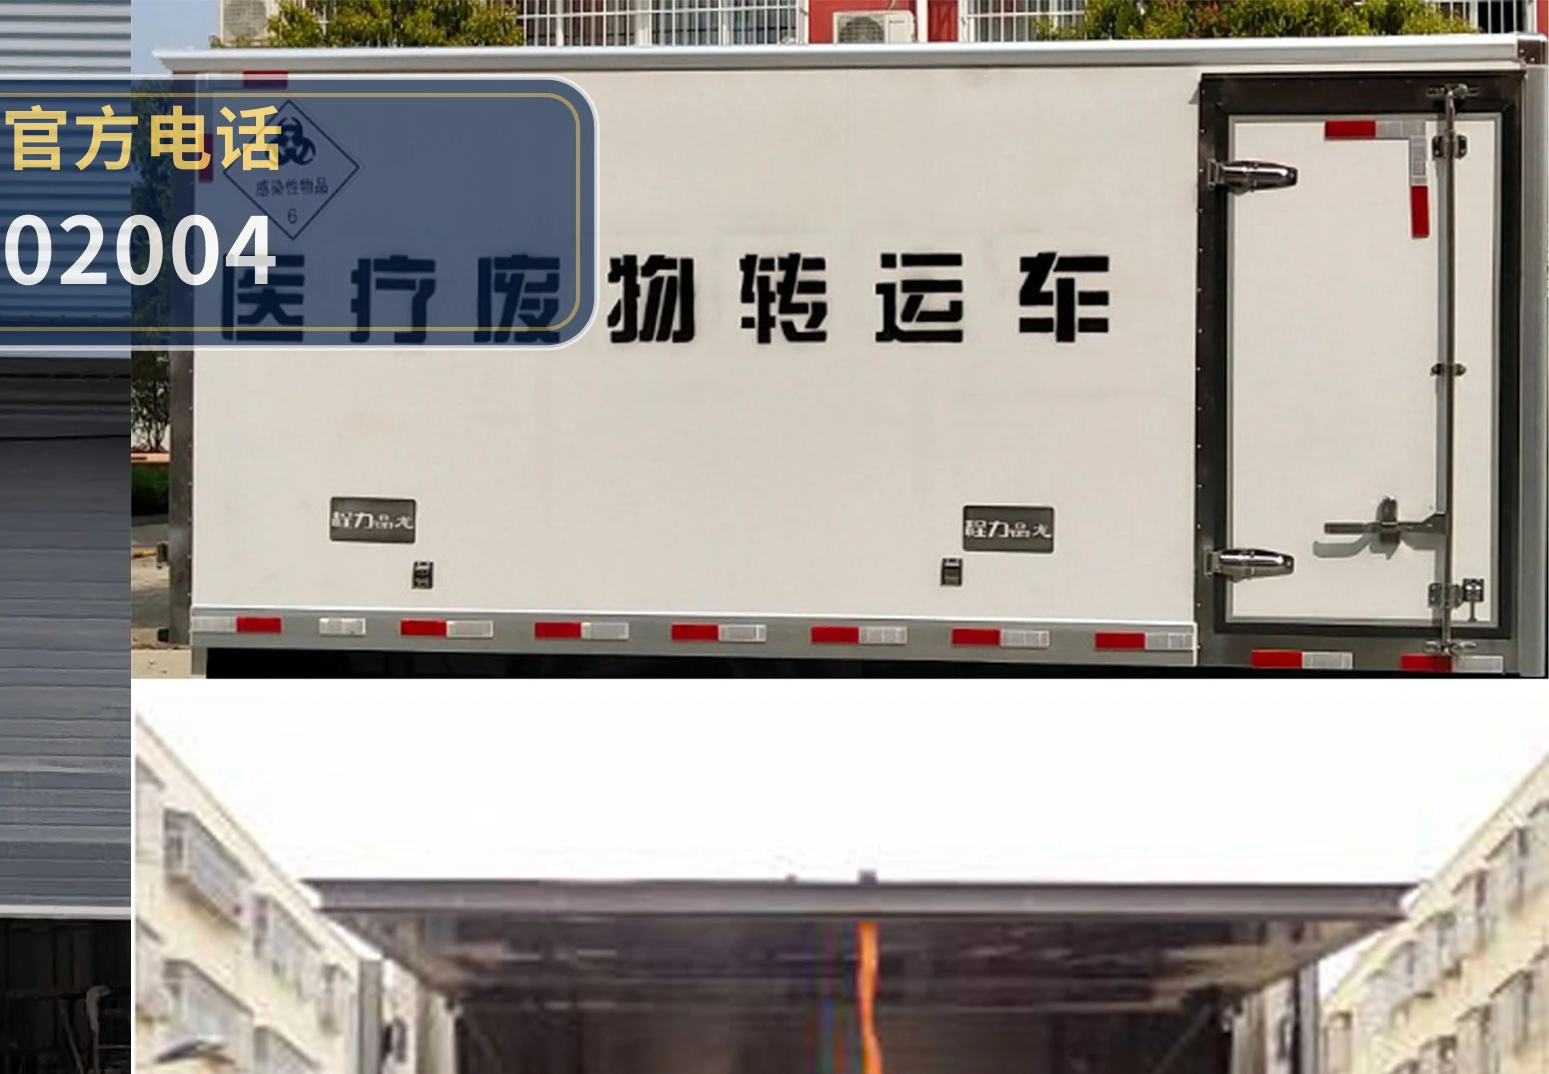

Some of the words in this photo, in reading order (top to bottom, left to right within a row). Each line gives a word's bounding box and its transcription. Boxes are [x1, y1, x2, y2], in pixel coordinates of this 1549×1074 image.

[256, 177, 329, 198] 感染性物品
[287, 208, 298, 225] 6
[221, 252, 1110, 344] 医疗废物转运车
